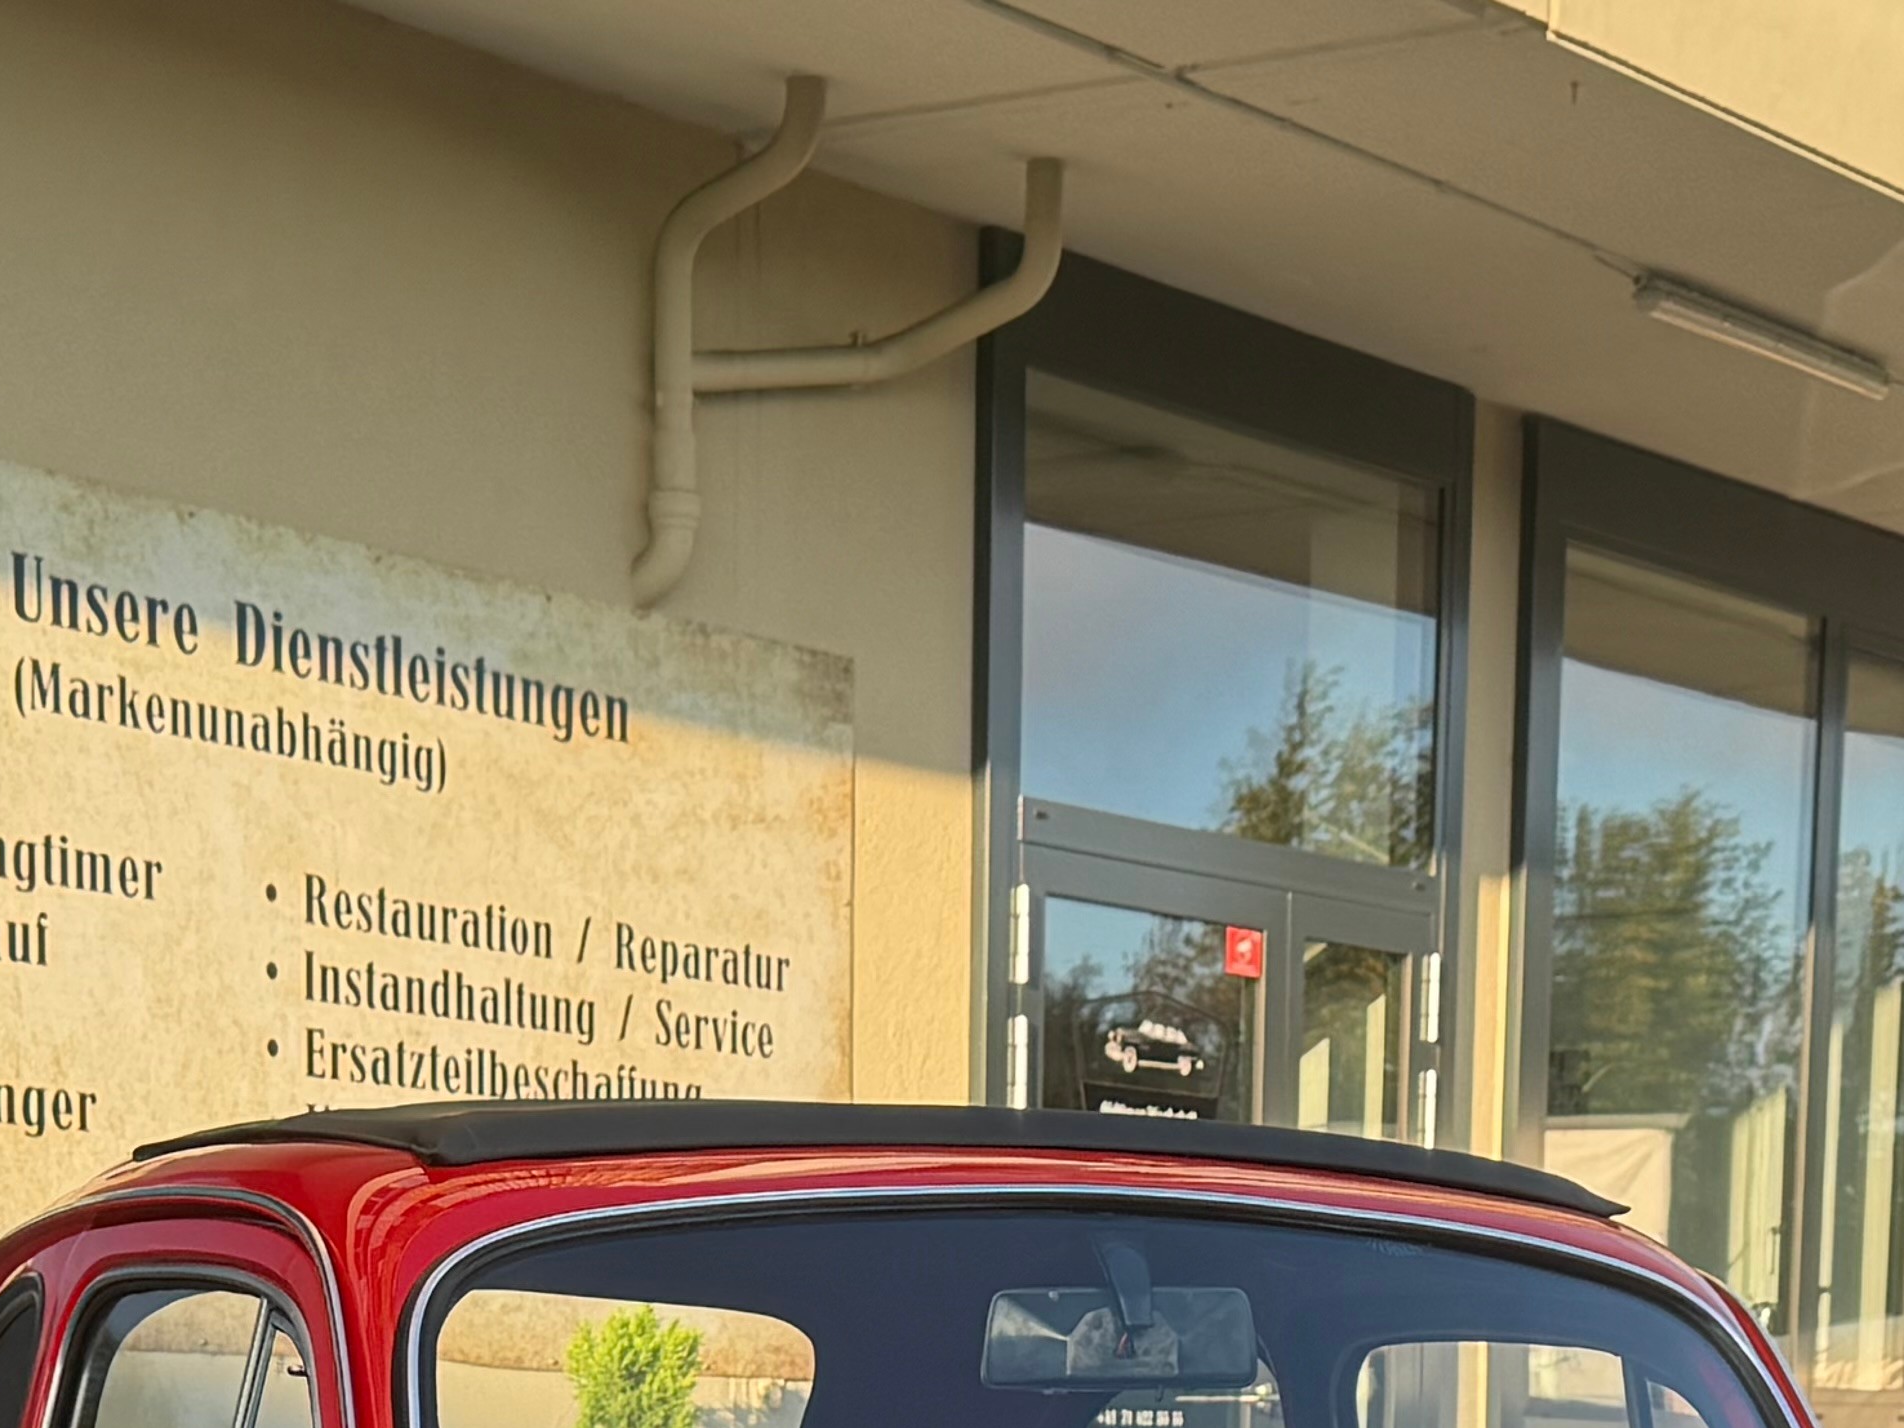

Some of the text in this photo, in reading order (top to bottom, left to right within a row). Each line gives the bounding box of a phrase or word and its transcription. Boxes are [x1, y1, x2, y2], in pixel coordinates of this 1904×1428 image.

[12, 553, 631, 743] Unsere Dienstleistungen
[15, 657, 447, 793] (Markenunabhängig)
[304, 873, 553, 959] Restauration
[614, 922, 791, 992] Reparatur
[304, 951, 596, 1045] Instandhaltung
[655, 999, 775, 1060] Service
[306, 1027, 702, 1099] Ersatzteilbeschaffu
